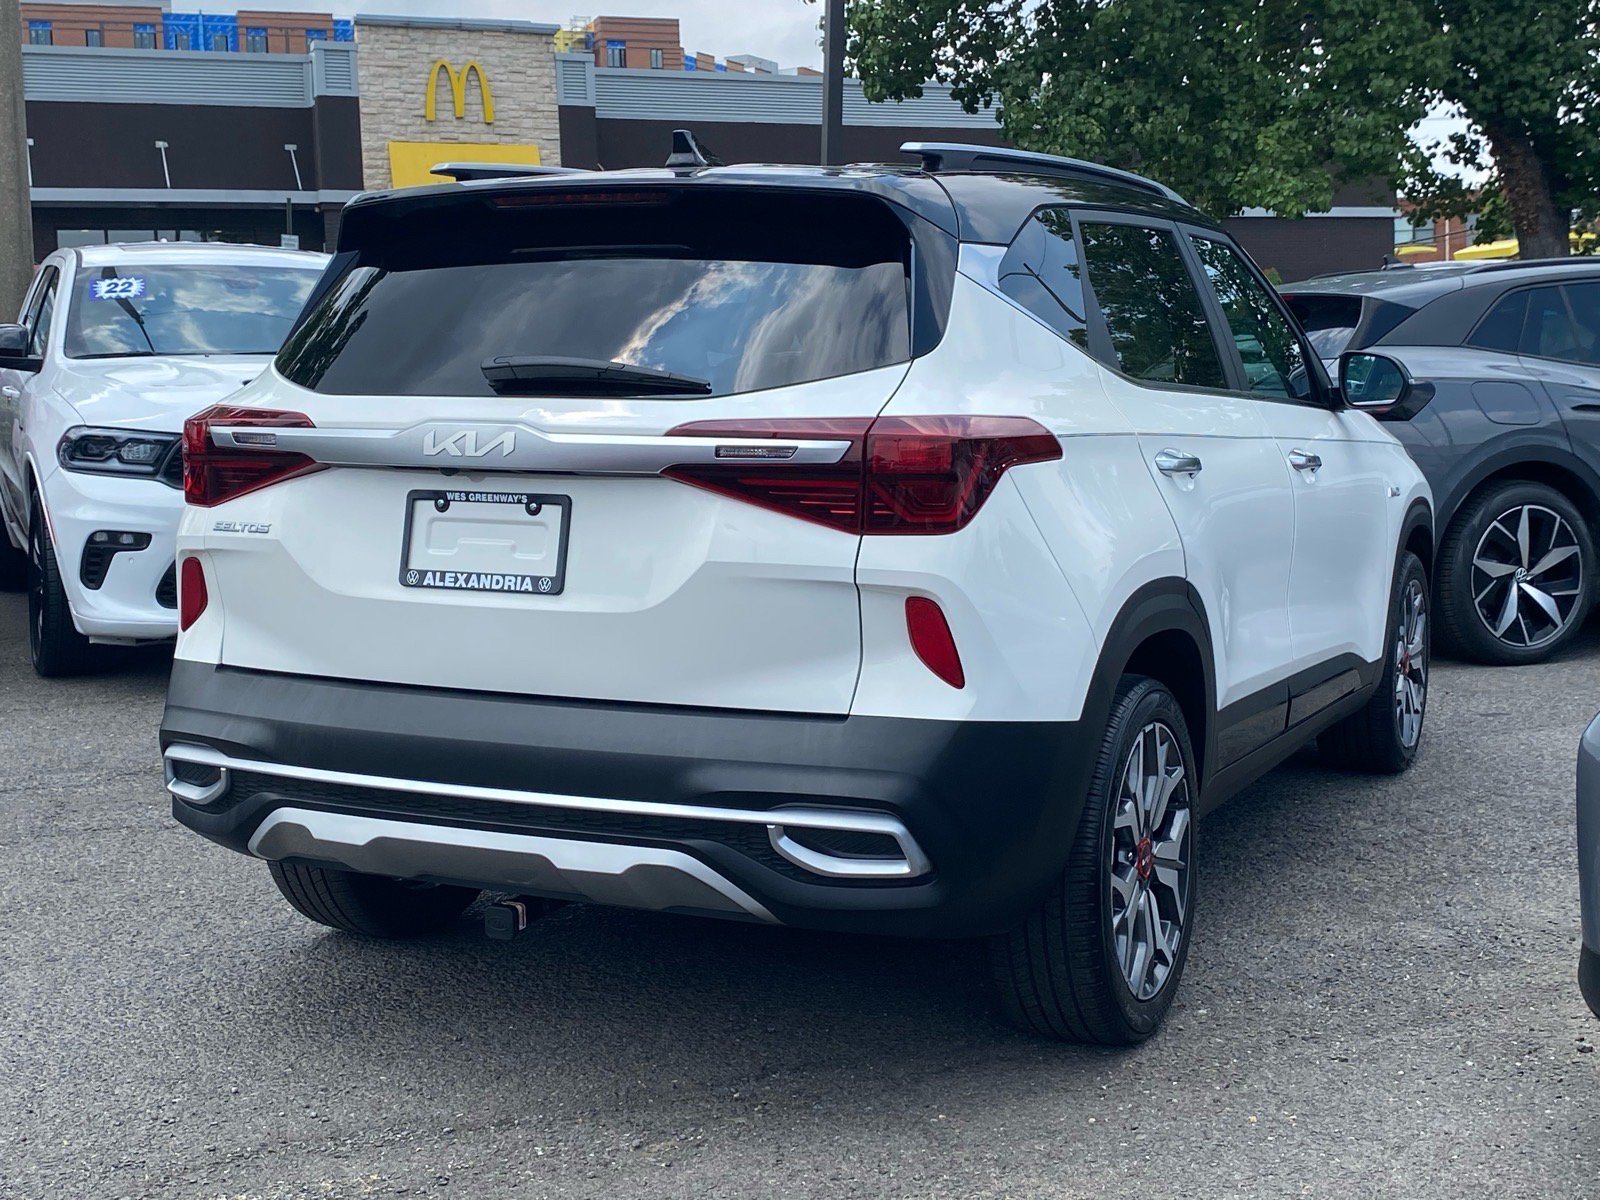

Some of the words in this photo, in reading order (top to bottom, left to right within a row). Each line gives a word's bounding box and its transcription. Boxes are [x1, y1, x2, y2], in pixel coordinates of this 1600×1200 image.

[104, 281, 133, 294] 22
[423, 429, 516, 457] KIA
[446, 492, 466, 501] WES
[468, 493, 528, 504] GREENWAY'S
[213, 521, 272, 533] SELTOS
[422, 571, 533, 592] ALEXANDRIA
